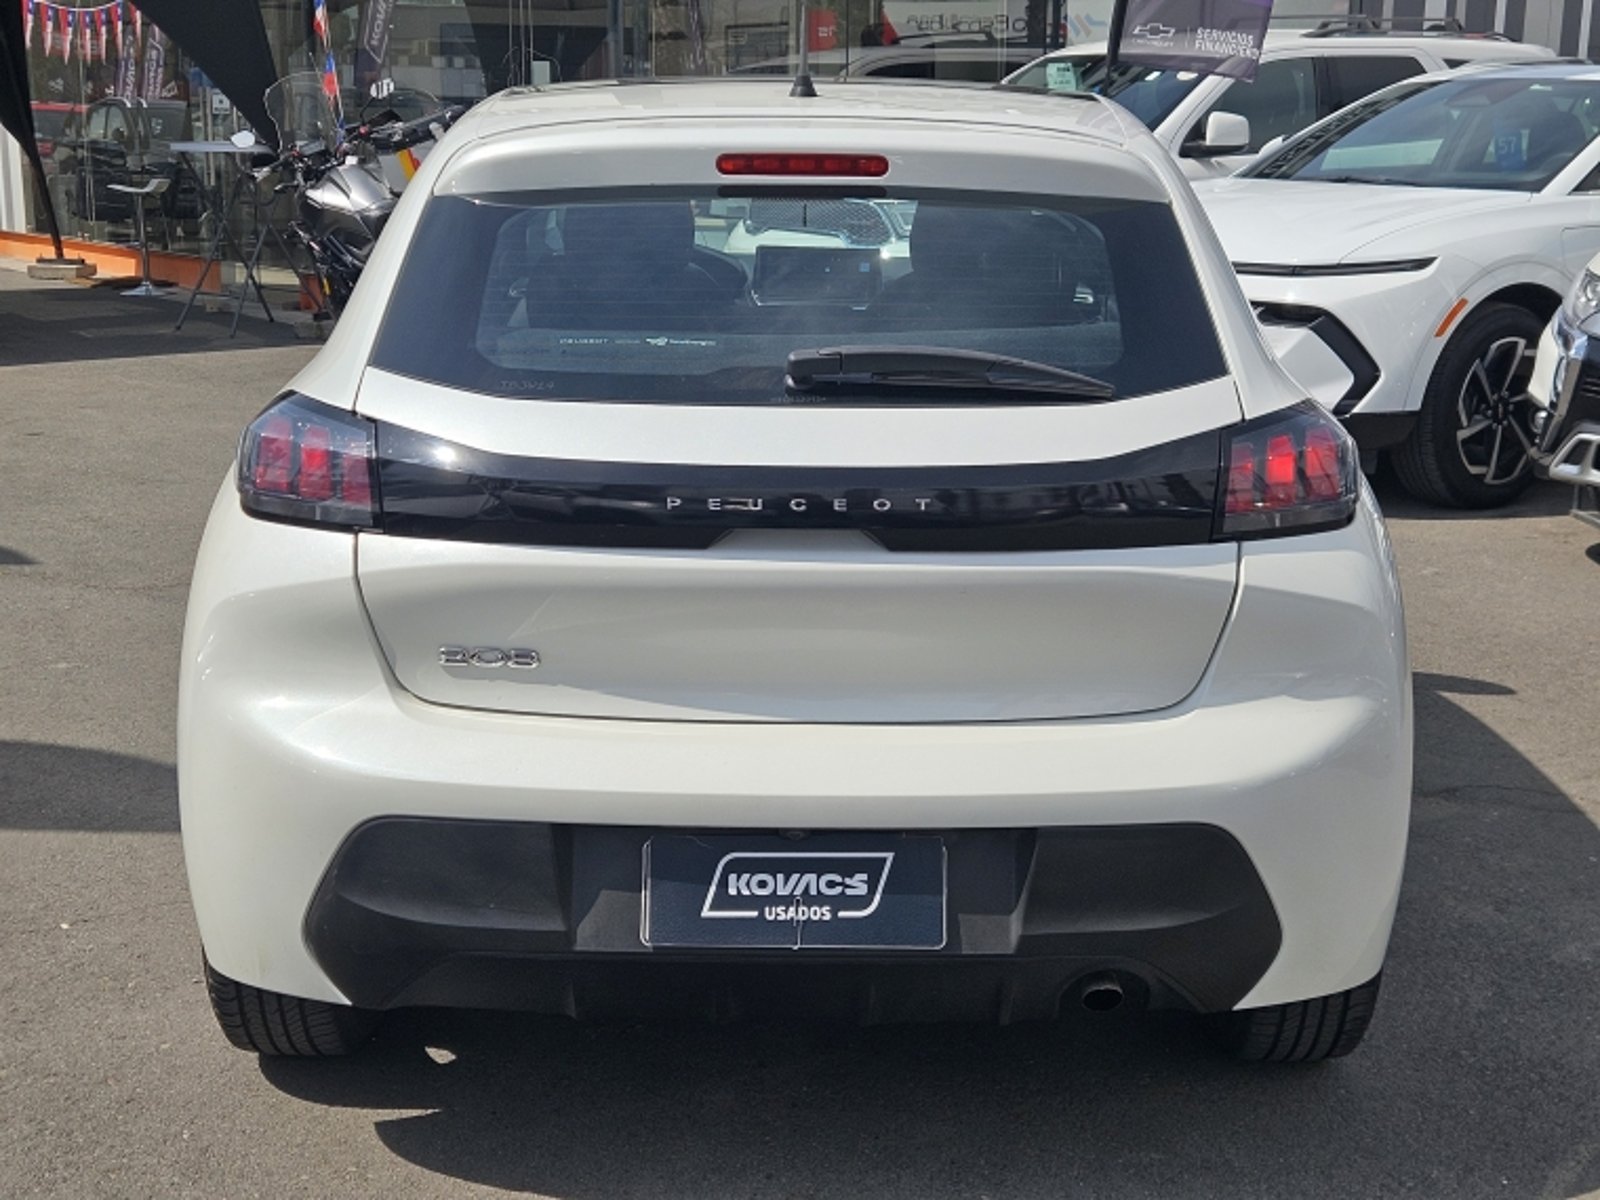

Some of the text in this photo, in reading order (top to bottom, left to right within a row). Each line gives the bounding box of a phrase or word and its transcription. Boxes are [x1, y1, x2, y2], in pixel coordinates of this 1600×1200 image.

[1195, 27, 1254, 47] SERVICIOS
[1194, 39, 1260, 60] FINANCIERO
[1498, 136, 1517, 154] 57
[666, 496, 933, 512] PEUGEOT
[439, 646, 541, 669] 208
[727, 873, 869, 897] KOVACS
[764, 905, 832, 922] USADOS
